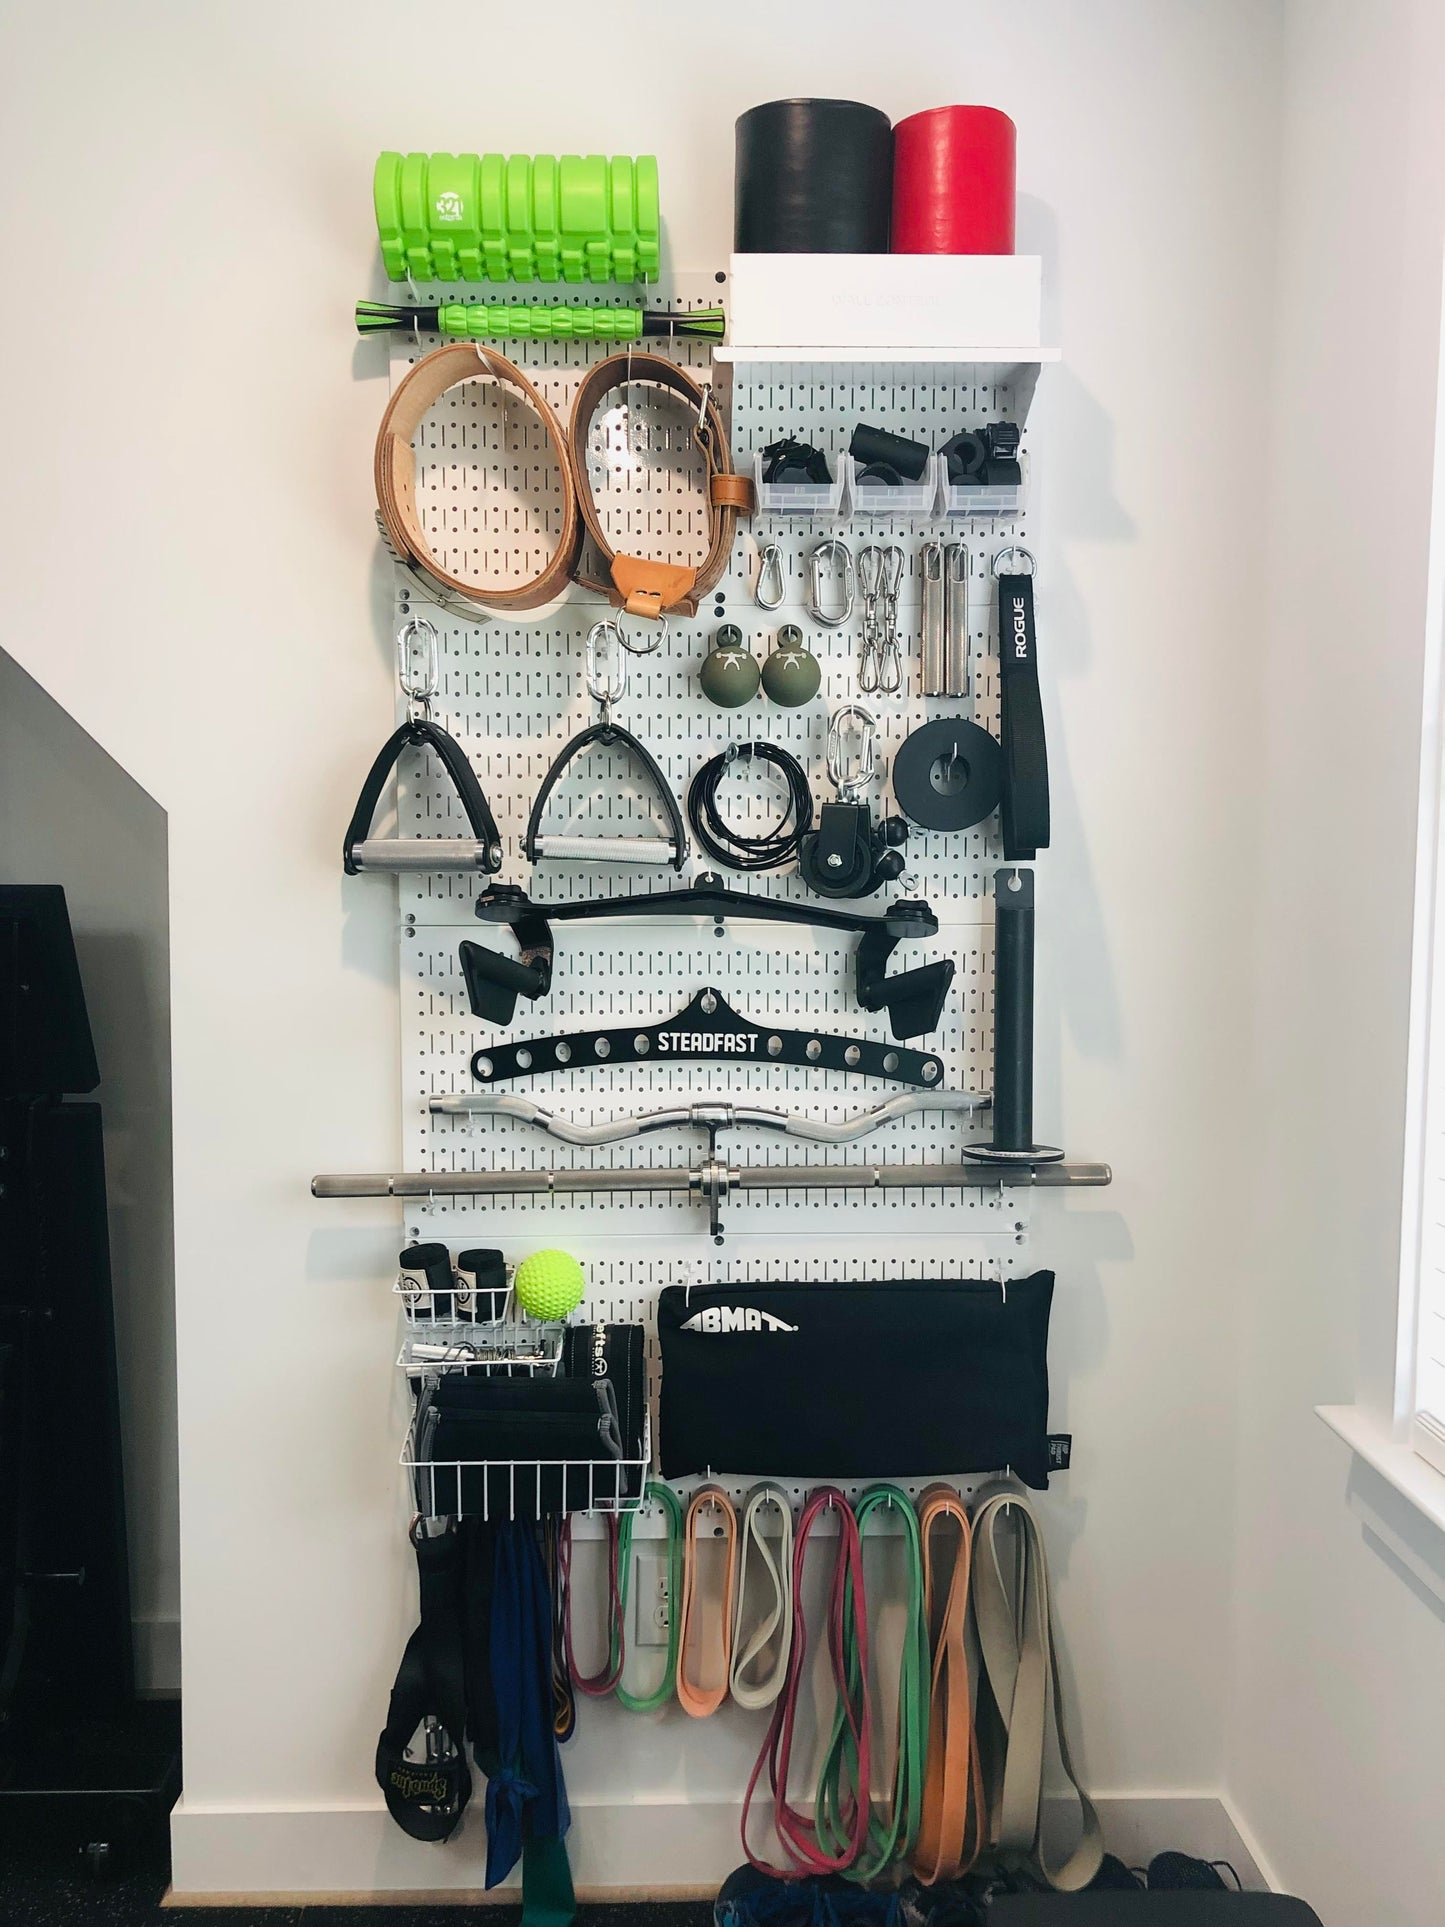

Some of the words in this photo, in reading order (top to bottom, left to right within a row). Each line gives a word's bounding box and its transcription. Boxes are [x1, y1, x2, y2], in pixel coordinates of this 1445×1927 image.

[1012, 597, 1027, 658] ROGUE
[658, 1031, 759, 1053] STEADFAST
[680, 1306, 794, 1333] ABMAT
